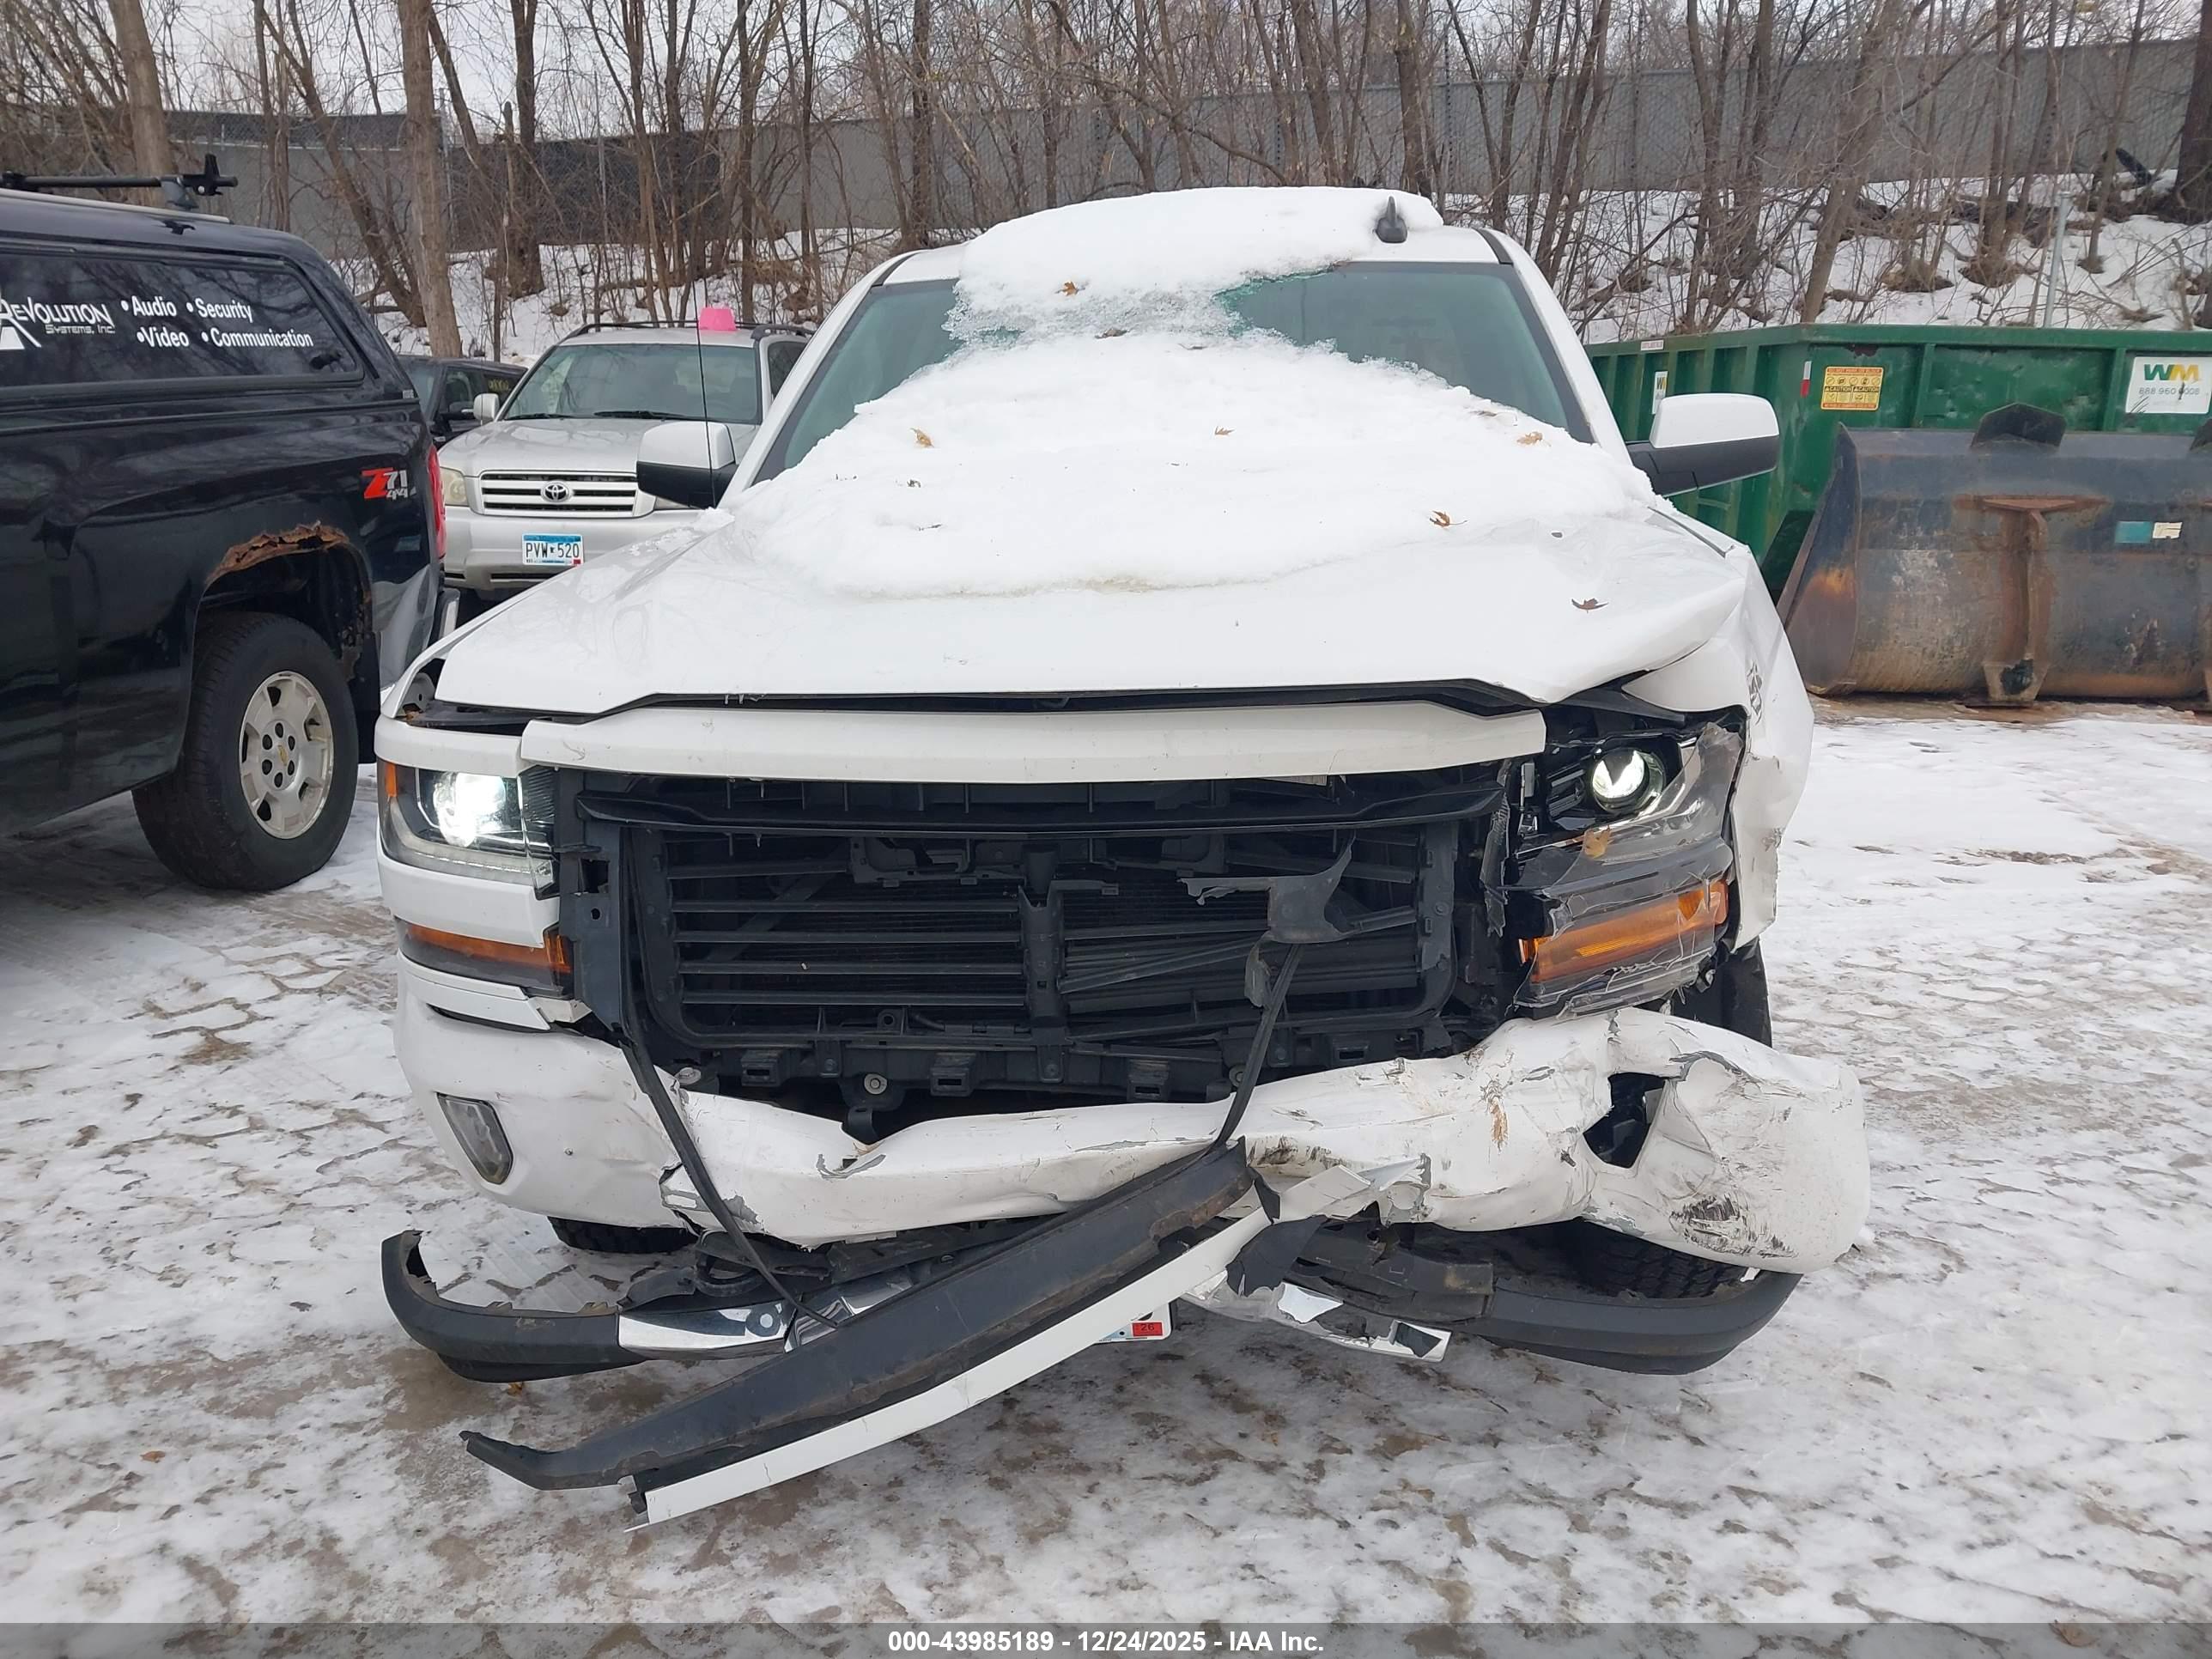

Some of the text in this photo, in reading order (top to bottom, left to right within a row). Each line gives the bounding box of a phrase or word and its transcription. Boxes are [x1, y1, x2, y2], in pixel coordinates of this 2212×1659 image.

[131, 295, 253, 323] Audio Security
[140, 326, 314, 348] Video Communication
[2143, 363, 2200, 381] WM
[362, 466, 408, 500] Z71
[526, 542, 580, 558] PVW 520
[1140, 1322, 1155, 1331] 26
